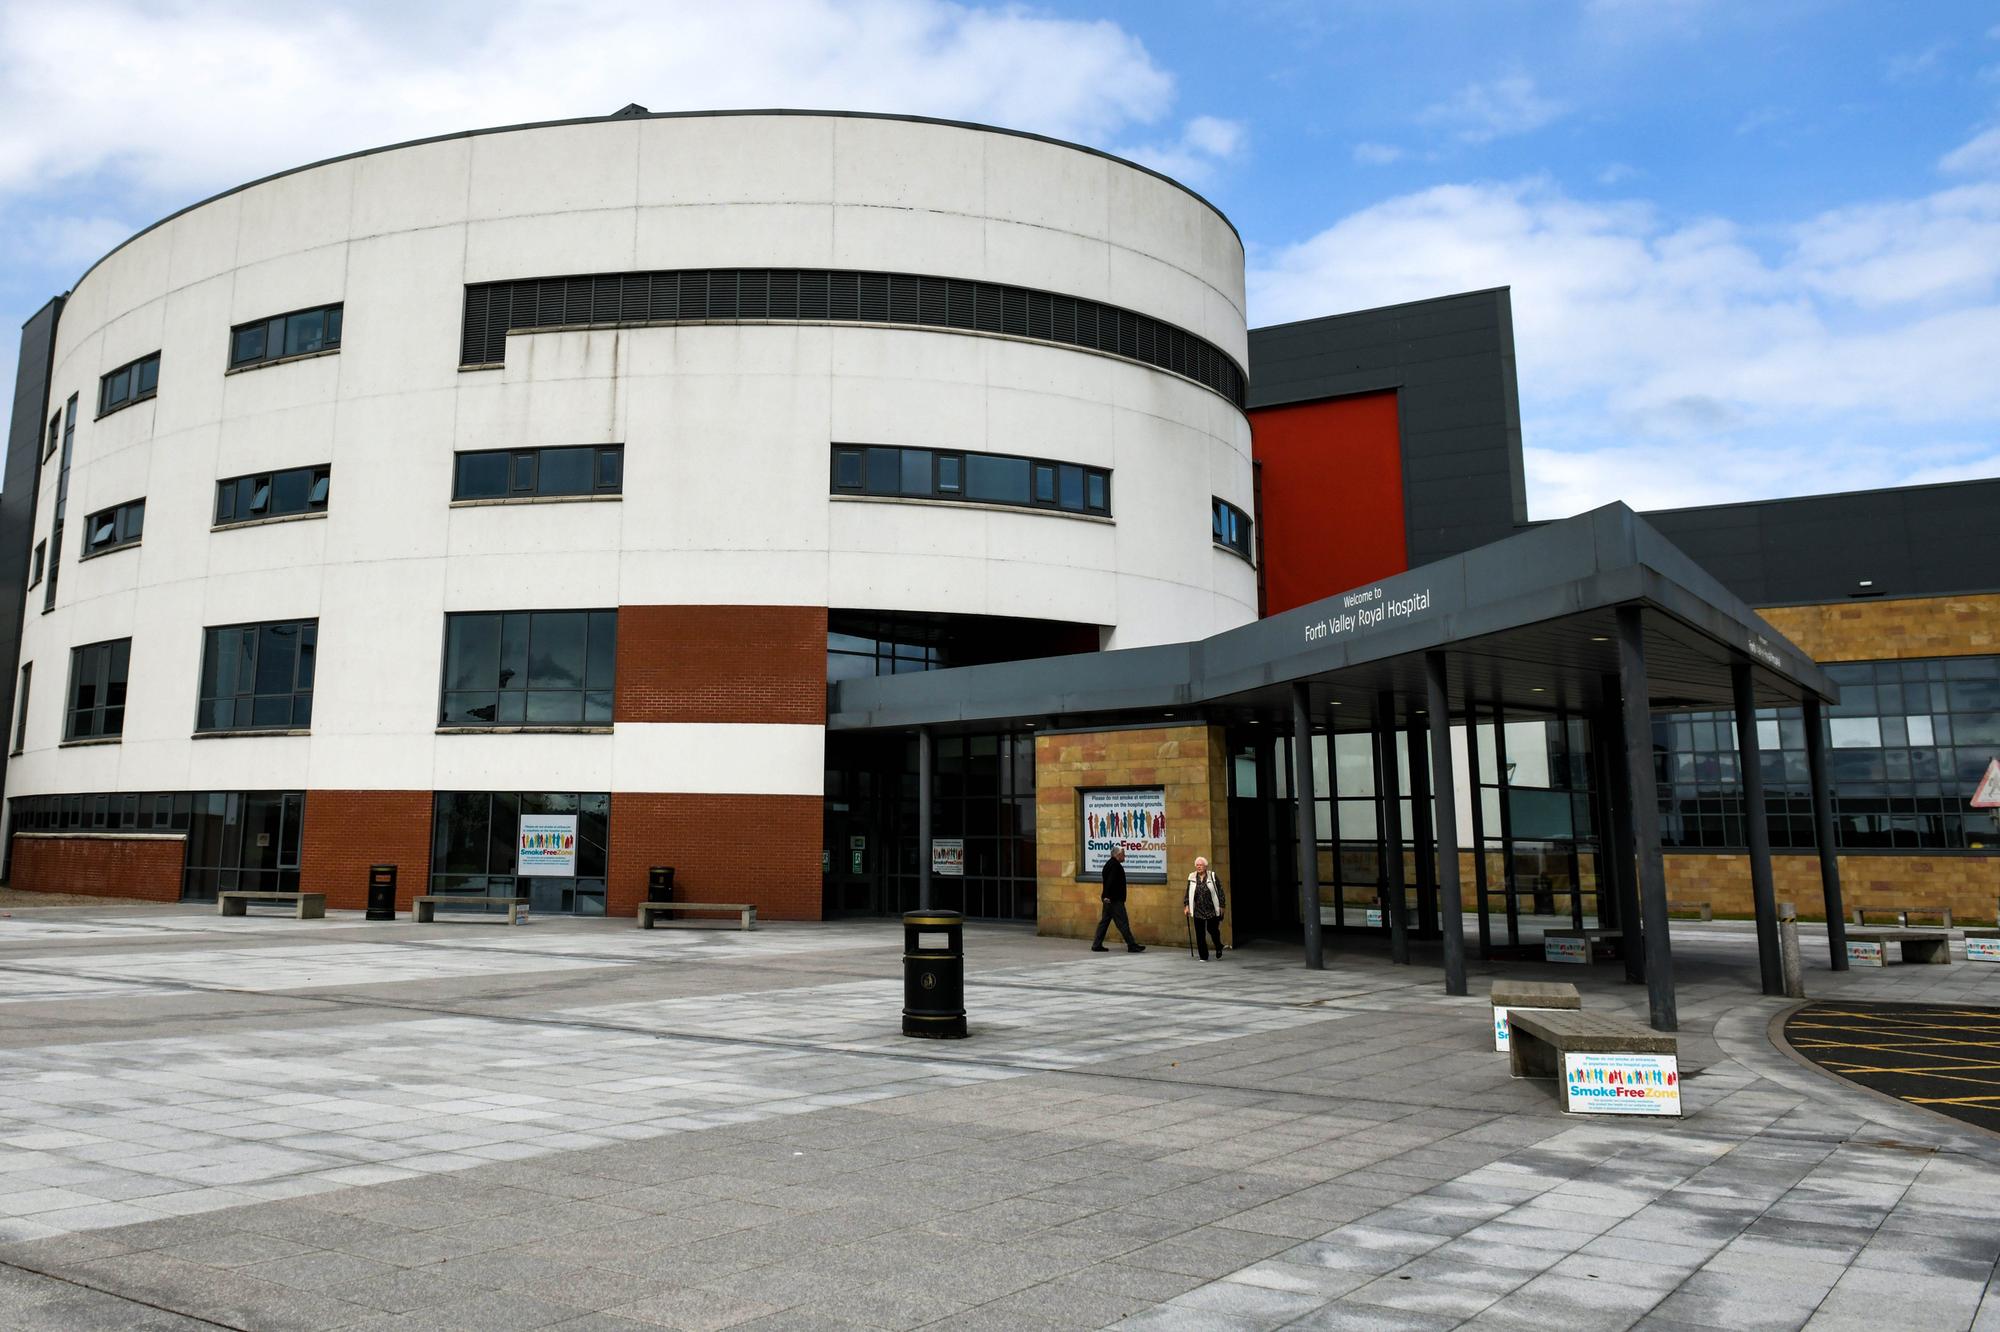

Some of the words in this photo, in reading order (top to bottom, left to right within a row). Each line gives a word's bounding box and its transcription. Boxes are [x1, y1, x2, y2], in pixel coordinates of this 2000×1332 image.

[1343, 591, 1373, 608] Welcome
[1374, 587, 1382, 599] to
[1305, 621, 1327, 642] Forth
[1329, 614, 1356, 633] Valley
[1358, 602, 1385, 627] Royal
[1387, 589, 1430, 618] Hospital
[1570, 1085, 1678, 1098] SmokeFreeZone
